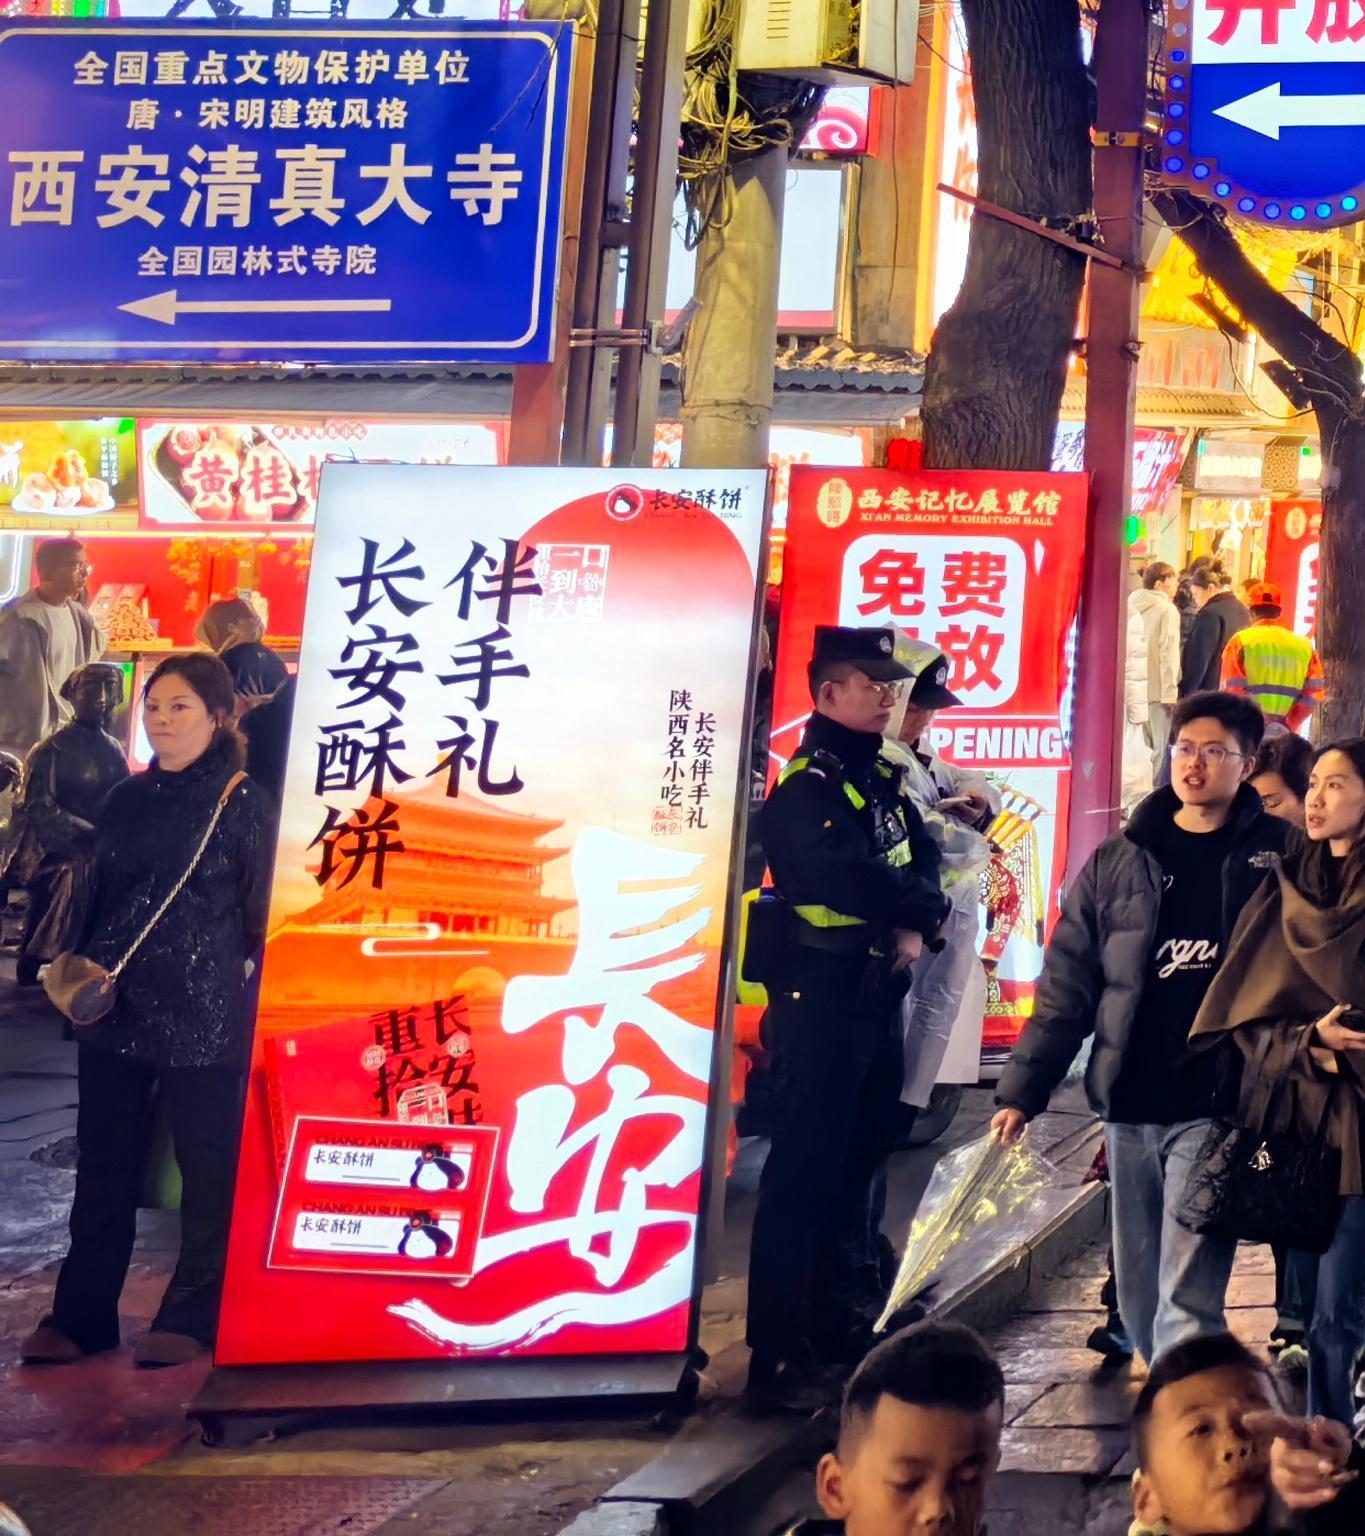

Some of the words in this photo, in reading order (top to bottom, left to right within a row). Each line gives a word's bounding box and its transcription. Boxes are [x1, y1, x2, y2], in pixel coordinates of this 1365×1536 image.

[74, 50, 471, 86] 全国重点文物保护单位
[126, 97, 409, 130] 唐·宋明建筑风格
[8, 144, 524, 229] 西安清真大寺
[137, 244, 379, 277] 全国园林式寺院
[857, 486, 1062, 516] 西安记忆展览馆
[856, 549, 1008, 619] 免费
[424, 538, 543, 798] 伴手礼
[306, 537, 433, 890] 长安酥饼
[661, 689, 694, 807] 陕西名小吃
[928, 726, 1063, 761] PENING
[685, 711, 717, 830] 长安伴手礼
[313, 1148, 374, 1168] 长安酥饼
[301, 1216, 362, 1235] 长安酥饼
